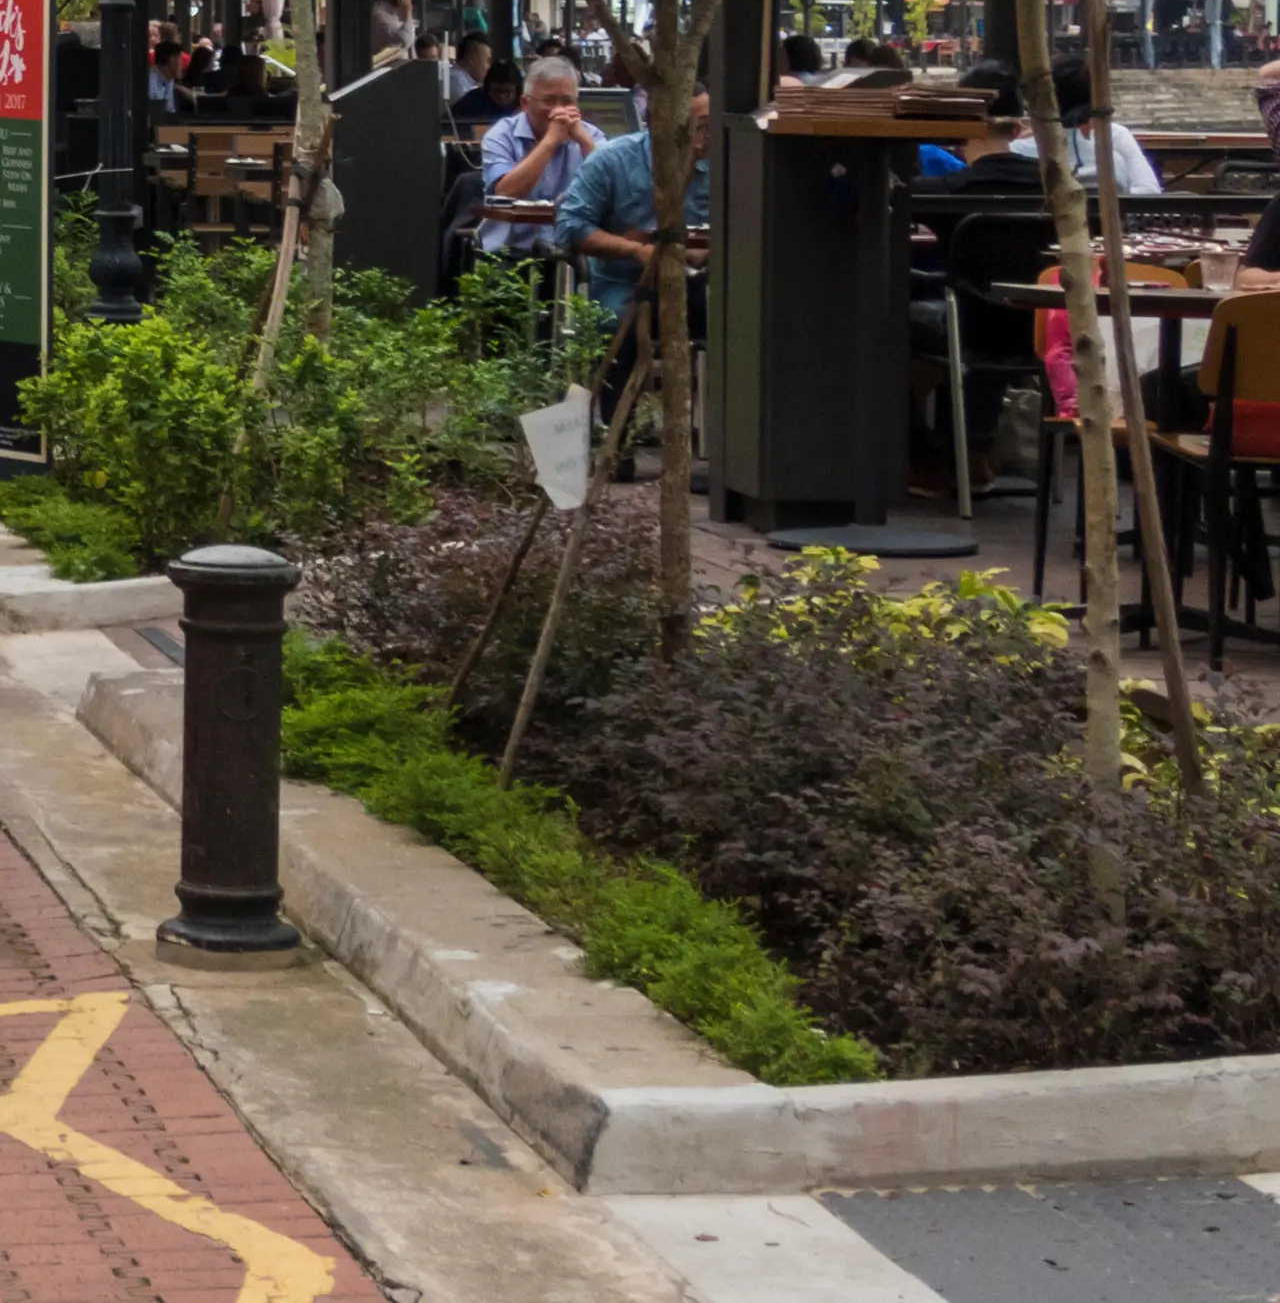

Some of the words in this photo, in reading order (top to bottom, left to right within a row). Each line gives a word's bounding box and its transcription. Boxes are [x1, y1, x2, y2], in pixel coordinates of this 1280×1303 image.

[4, 94, 27, 109] 2017
[18, 147, 33, 157] AND
[4, 282, 13, 295] &
